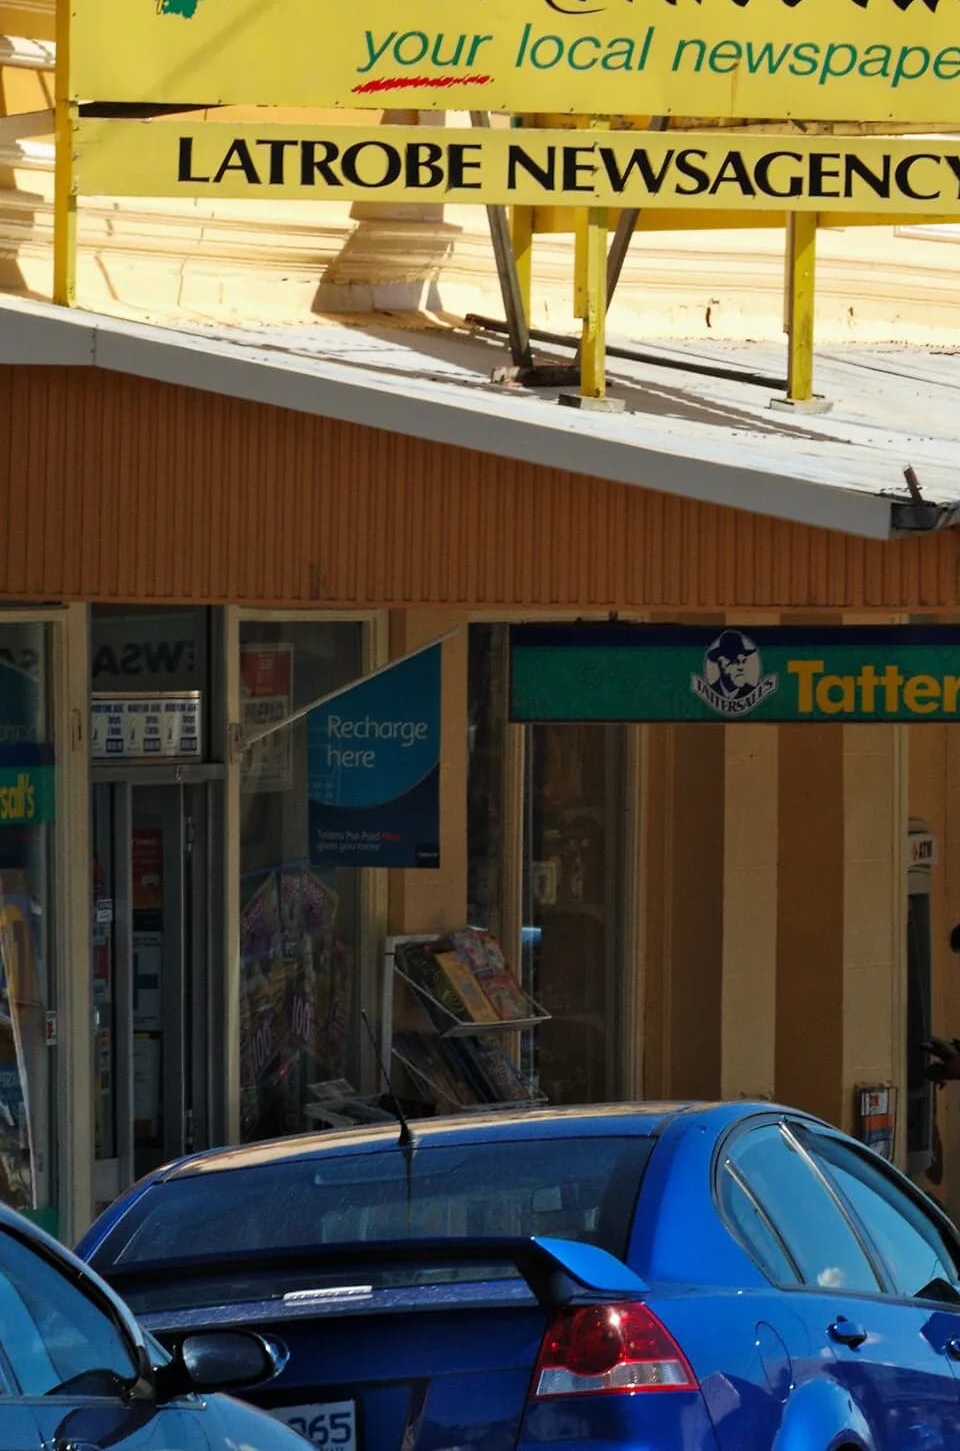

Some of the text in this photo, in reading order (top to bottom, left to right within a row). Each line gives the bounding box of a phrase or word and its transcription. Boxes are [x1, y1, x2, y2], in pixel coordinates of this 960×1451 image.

[357, 29, 493, 73] your
[515, 23, 655, 71] local
[178, 136, 482, 190] LATROBE
[327, 715, 428, 747] Recharge
[327, 745, 375, 767] here
